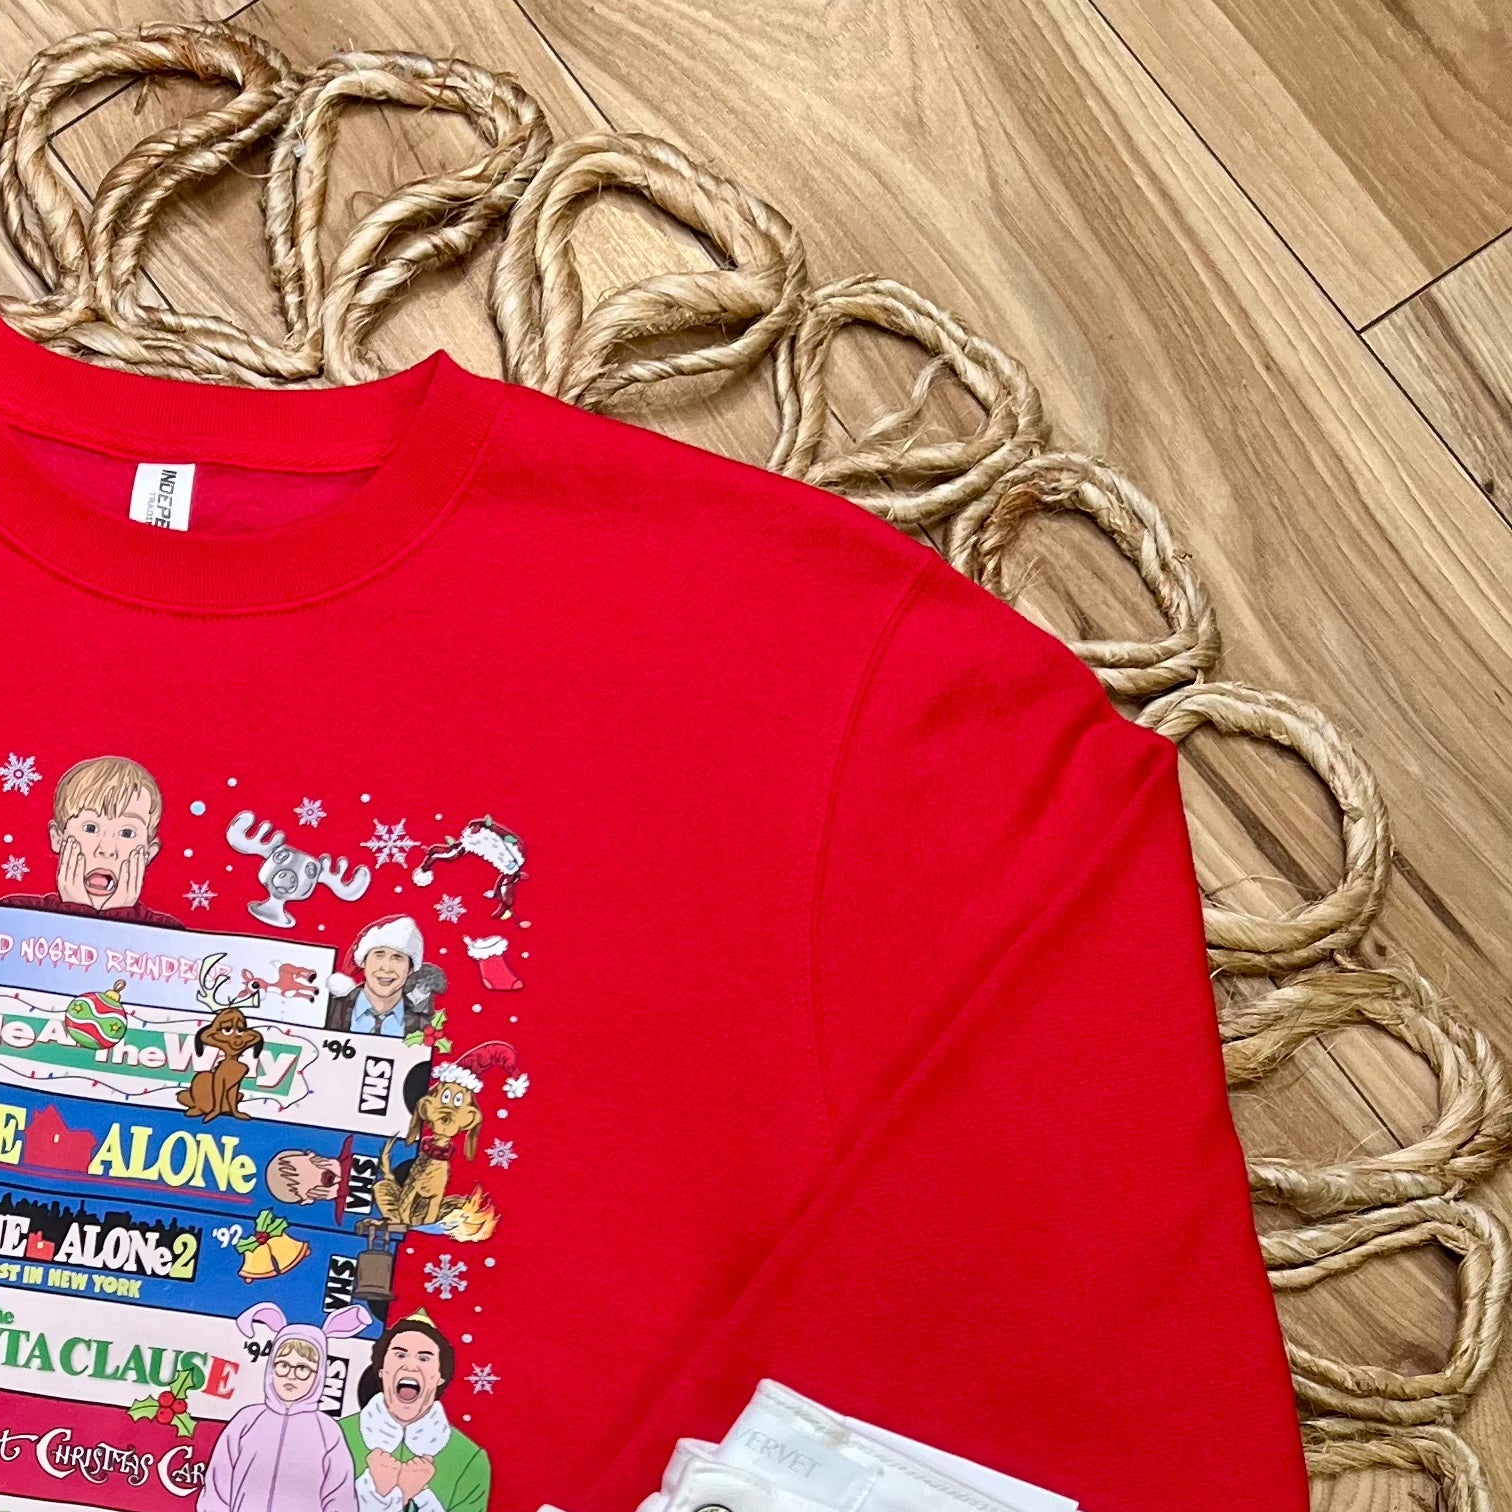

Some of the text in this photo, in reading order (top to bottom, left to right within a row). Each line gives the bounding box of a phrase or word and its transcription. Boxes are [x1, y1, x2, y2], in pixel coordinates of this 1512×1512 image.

[21, 937, 98, 972] NOSED
[322, 1038, 357, 1061] '96
[359, 1057, 393, 1113] VHS
[345, 1153, 380, 1214] VHS
[22, 1265, 45, 1285] IN
[47, 1268, 89, 1292] NEW
[91, 1273, 143, 1299] YORK
[323, 1254, 358, 1312] VHS
[59, 1336, 241, 1400] CLAUSE
